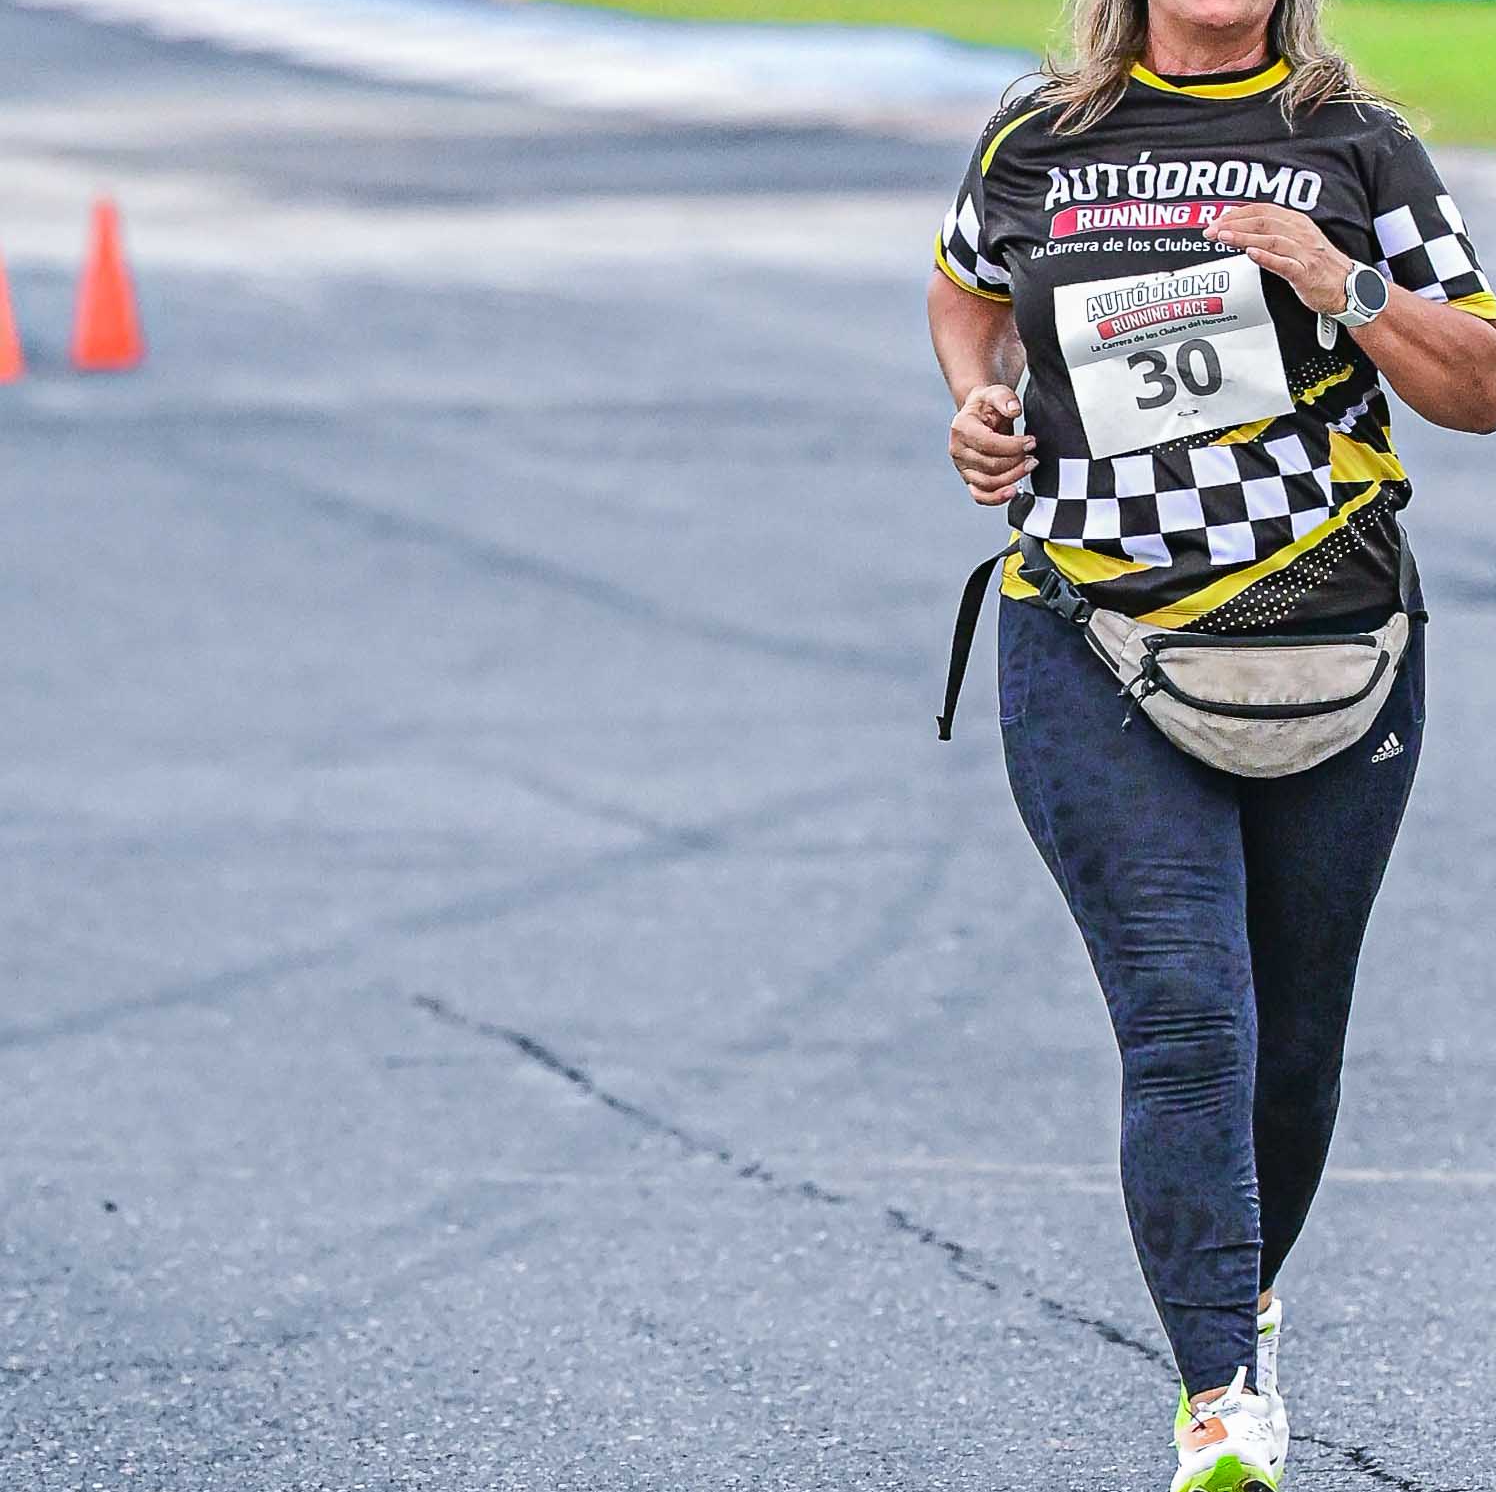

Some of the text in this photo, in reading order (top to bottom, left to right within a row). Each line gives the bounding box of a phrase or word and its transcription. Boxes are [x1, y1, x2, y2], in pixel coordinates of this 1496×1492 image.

[1044, 151, 1323, 211] AUTÓDROMO
[1076, 203, 1191, 227] RUNNING
[1030, 246, 1045, 259] La
[1046, 241, 1099, 256] Carrera
[1102, 237, 1124, 252] de
[1127, 237, 1151, 252] los
[1154, 236, 1211, 252] Clubes
[1087, 271, 1230, 322] AUTÓDROMO
[1111, 300, 1209, 334] RUNNING RACE
[1090, 344, 1101, 353] La
[1102, 337, 1132, 350] Carrera
[1133, 334, 1145, 343] de
[1145, 331, 1158, 340] los
[1158, 325, 1187, 336] Clubes
[1187, 320, 1202, 329] del
[1126, 338, 1222, 410] 30
